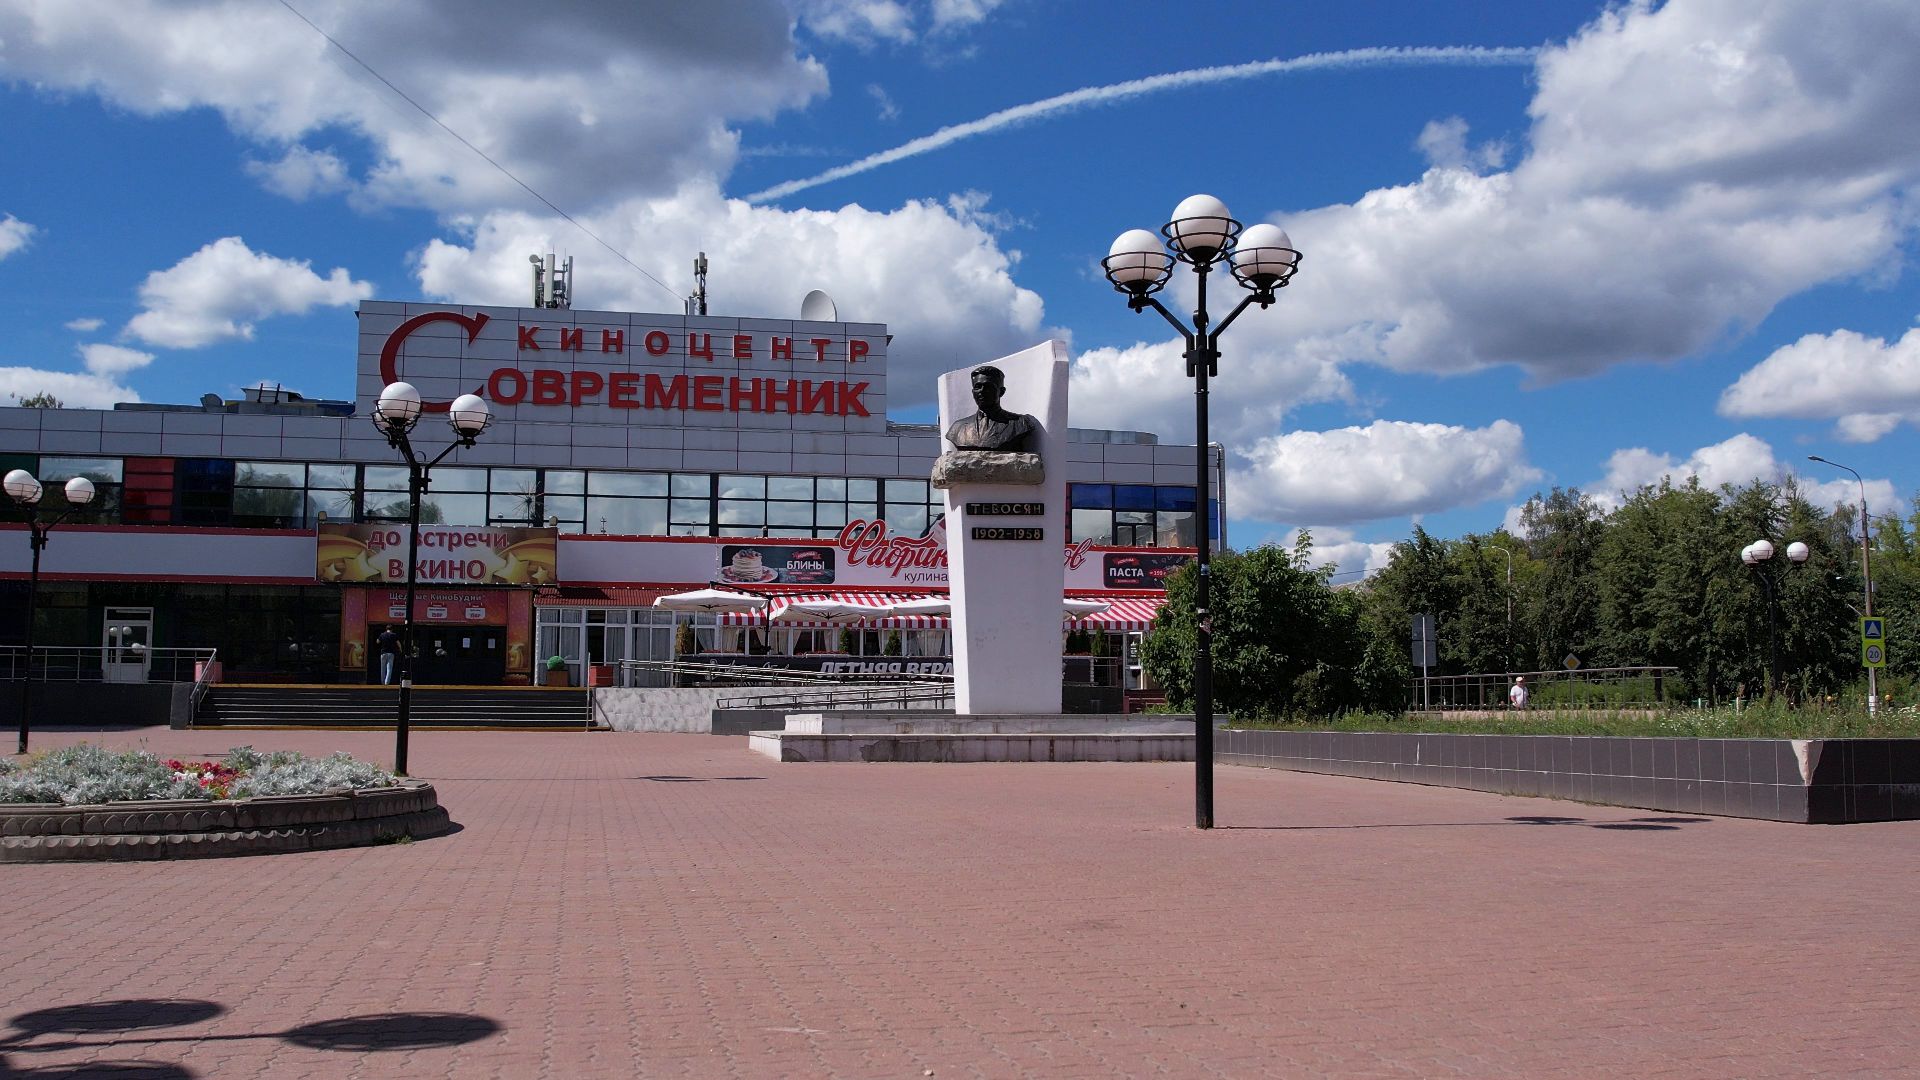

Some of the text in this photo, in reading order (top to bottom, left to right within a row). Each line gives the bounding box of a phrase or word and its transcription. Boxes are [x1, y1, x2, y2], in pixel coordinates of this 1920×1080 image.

[518, 325, 870, 363] КИНОЦЕНТР
[380, 312, 871, 417] СОВРЕМЕННИК
[975, 528, 1041, 540] 1902-1958
[786, 560, 825, 570] БЛИНЫ
[1109, 567, 1145, 577] ПАСТА
[1868, 650, 1880, 659] 20
